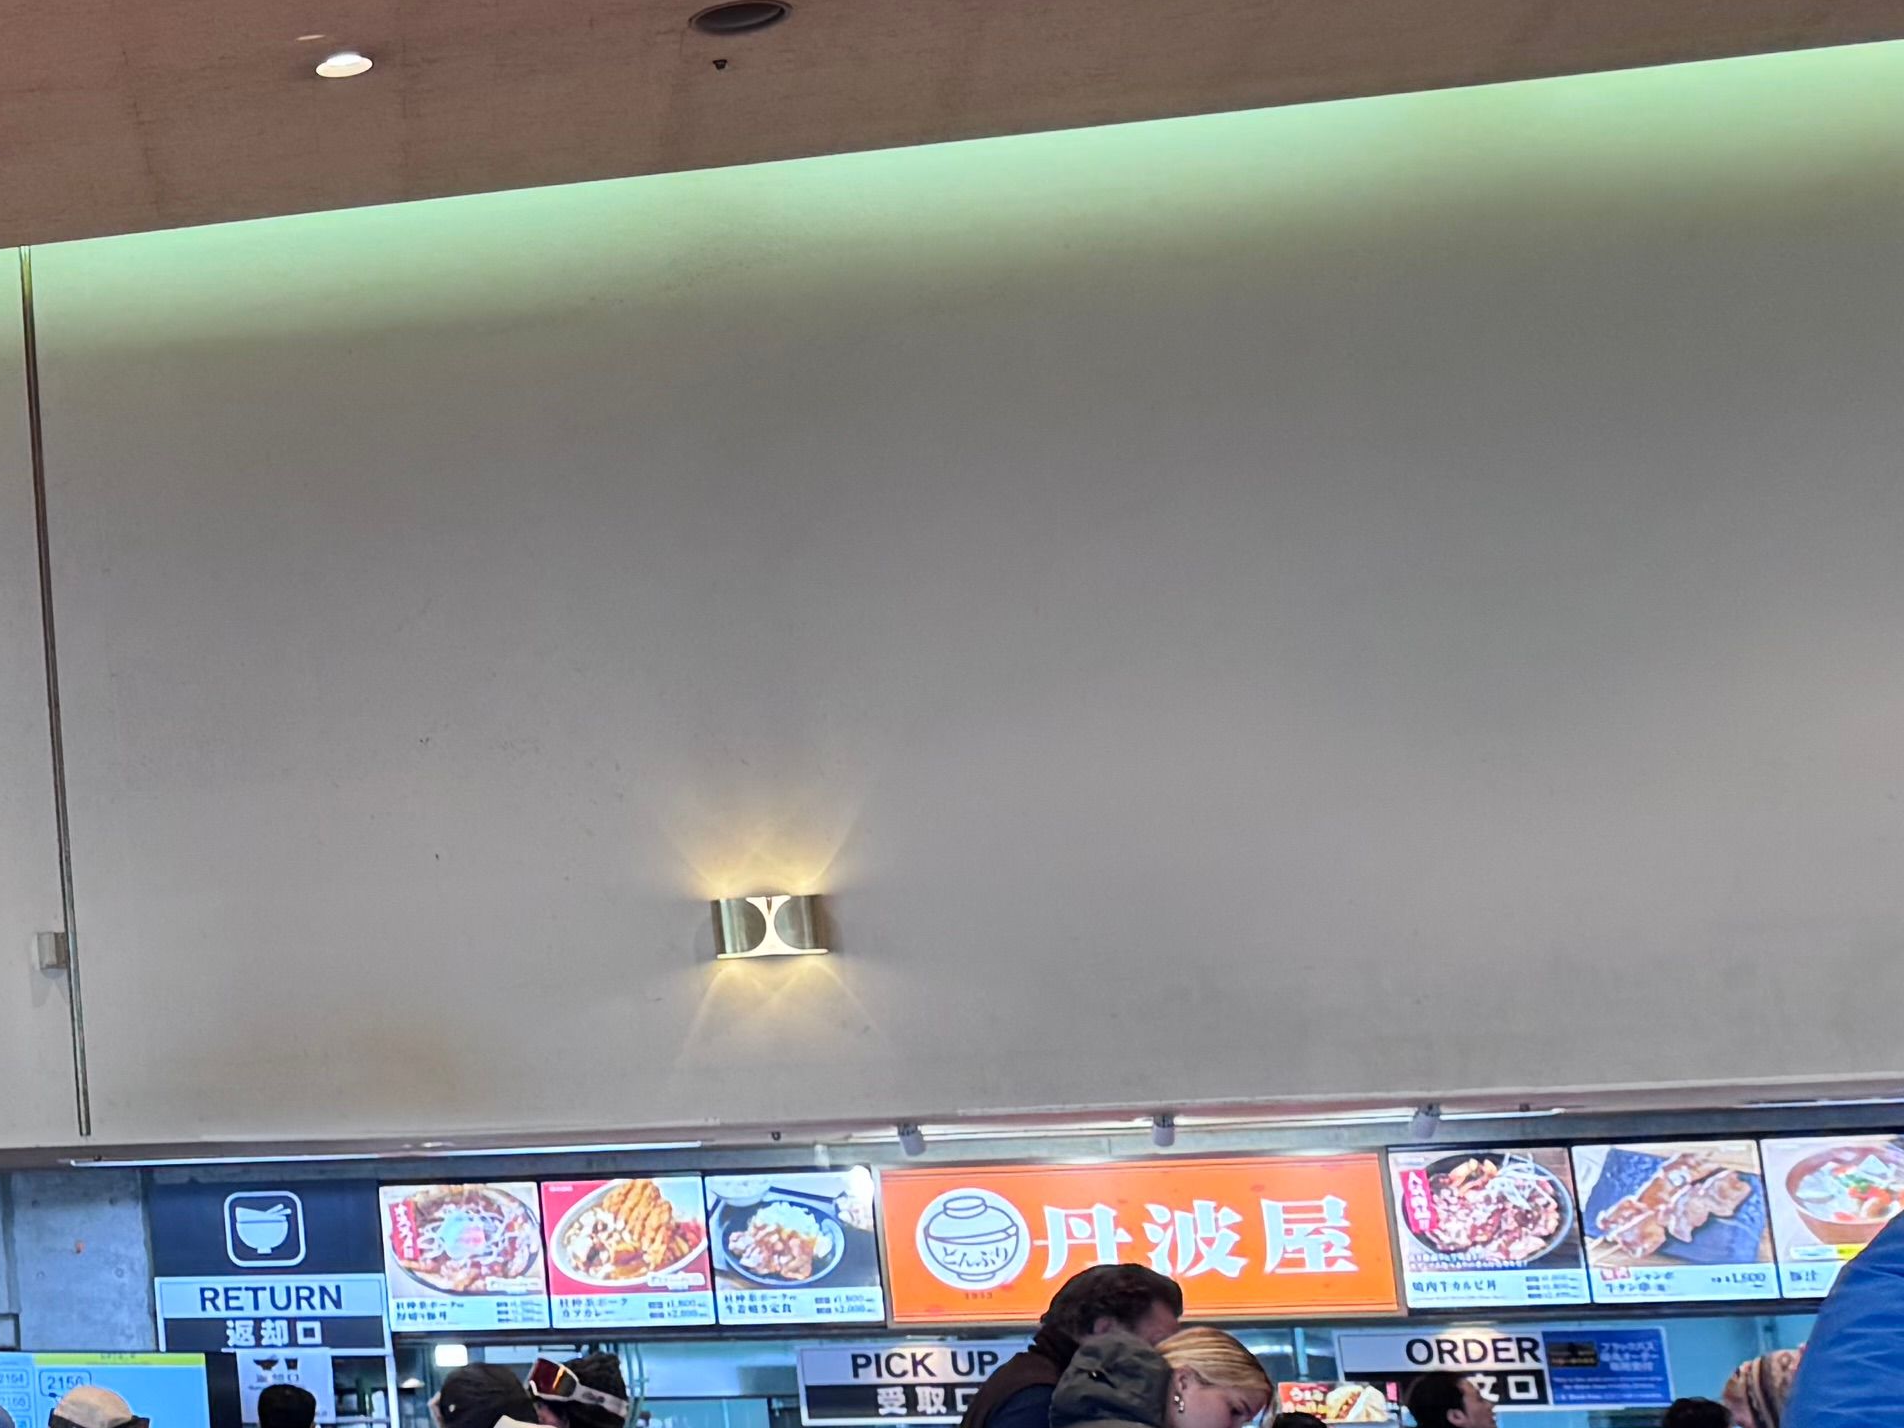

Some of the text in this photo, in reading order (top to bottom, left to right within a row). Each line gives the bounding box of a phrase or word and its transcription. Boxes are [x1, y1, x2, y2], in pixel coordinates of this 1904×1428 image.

[1033, 1196, 1358, 1281] 丹波屋
[942, 1246, 1008, 1268] どんぶり
[199, 1285, 343, 1311] RETURN
[226, 1319, 322, 1346] 返却口
[852, 1350, 999, 1379] PICK UP
[1406, 1337, 1542, 1365] ORDER
[1466, 1374, 1539, 1402] 文口
